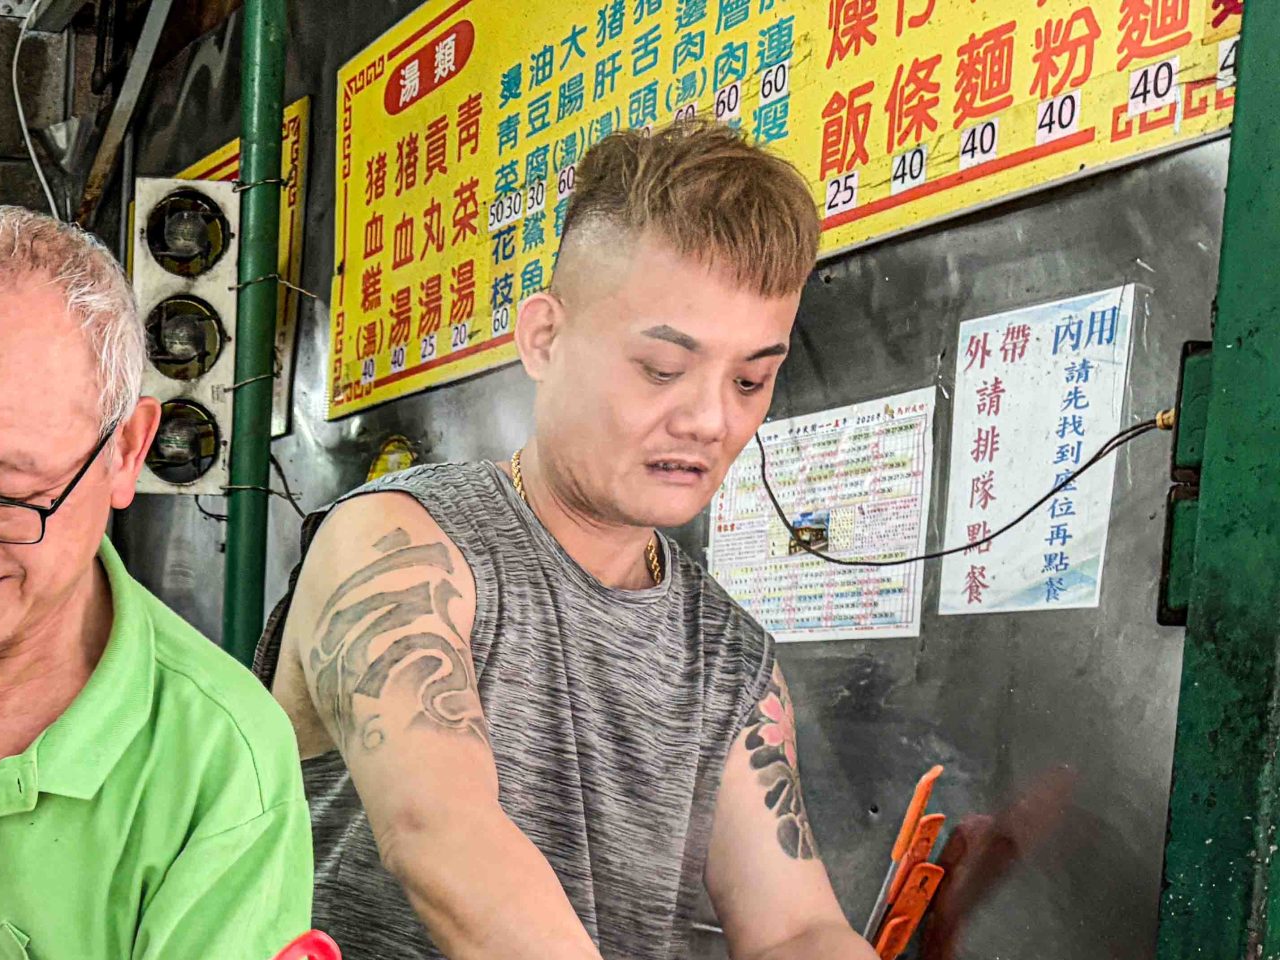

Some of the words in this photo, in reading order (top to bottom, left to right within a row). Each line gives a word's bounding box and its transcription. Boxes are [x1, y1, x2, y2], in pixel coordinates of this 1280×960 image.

[397, 32, 458, 108] 湯類
[1029, 6, 1102, 99] 粉
[761, 63, 787, 99] 60
[953, 21, 1017, 130] 麵
[1130, 61, 1173, 104] 40
[525, 44, 554, 187] 油豆腐
[553, 24, 588, 174] 大腸(湯)
[715, 84, 739, 118] 60
[1038, 94, 1076, 134] 40
[961, 121, 997, 159] 40
[558, 164, 575, 194] 60
[892, 147, 925, 186] 40
[527, 181, 545, 210] 30
[827, 175, 856, 212] 25
[416, 113, 451, 340] 貢丸湯
[489, 224, 517, 311] 花枝
[451, 325, 467, 348] 20
[493, 307, 509, 332] 60
[1051, 305, 1118, 355] 內用
[390, 345, 405, 370] 40
[420, 336, 436, 360] 25
[963, 323, 1032, 373] 外帶
[361, 357, 375, 381] 40
[961, 376, 1006, 605] 請排隊點餐
[1040, 360, 1095, 604] 請先找到座位再點餐
